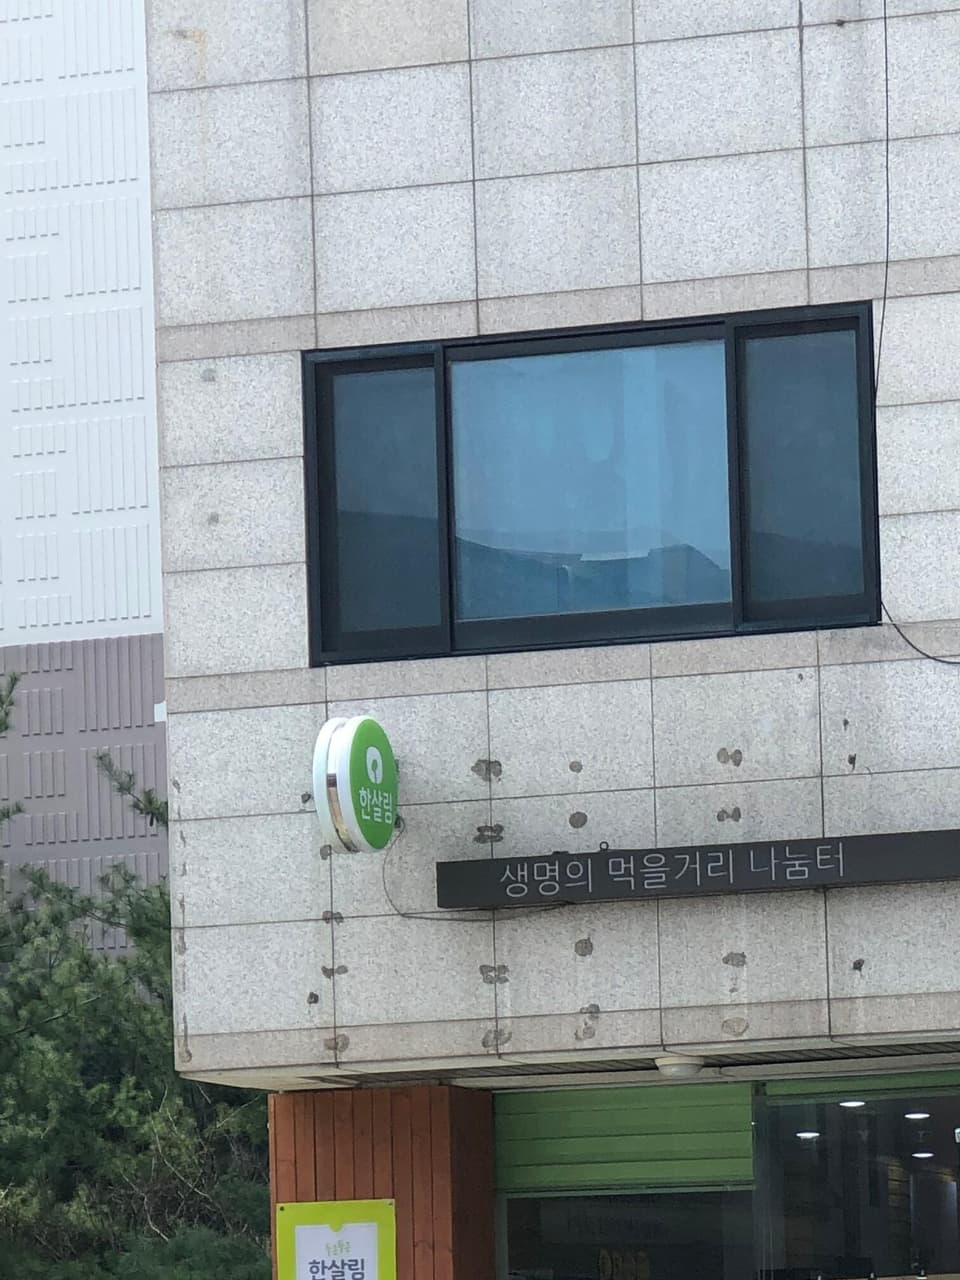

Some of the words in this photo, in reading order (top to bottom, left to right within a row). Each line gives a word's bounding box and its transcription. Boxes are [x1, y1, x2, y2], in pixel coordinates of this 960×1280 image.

[359, 787, 393, 825] 한살림
[500, 858, 592, 898] 생명의
[608, 849, 734, 891] 먹을거리
[749, 841, 844, 880] 나눔터
